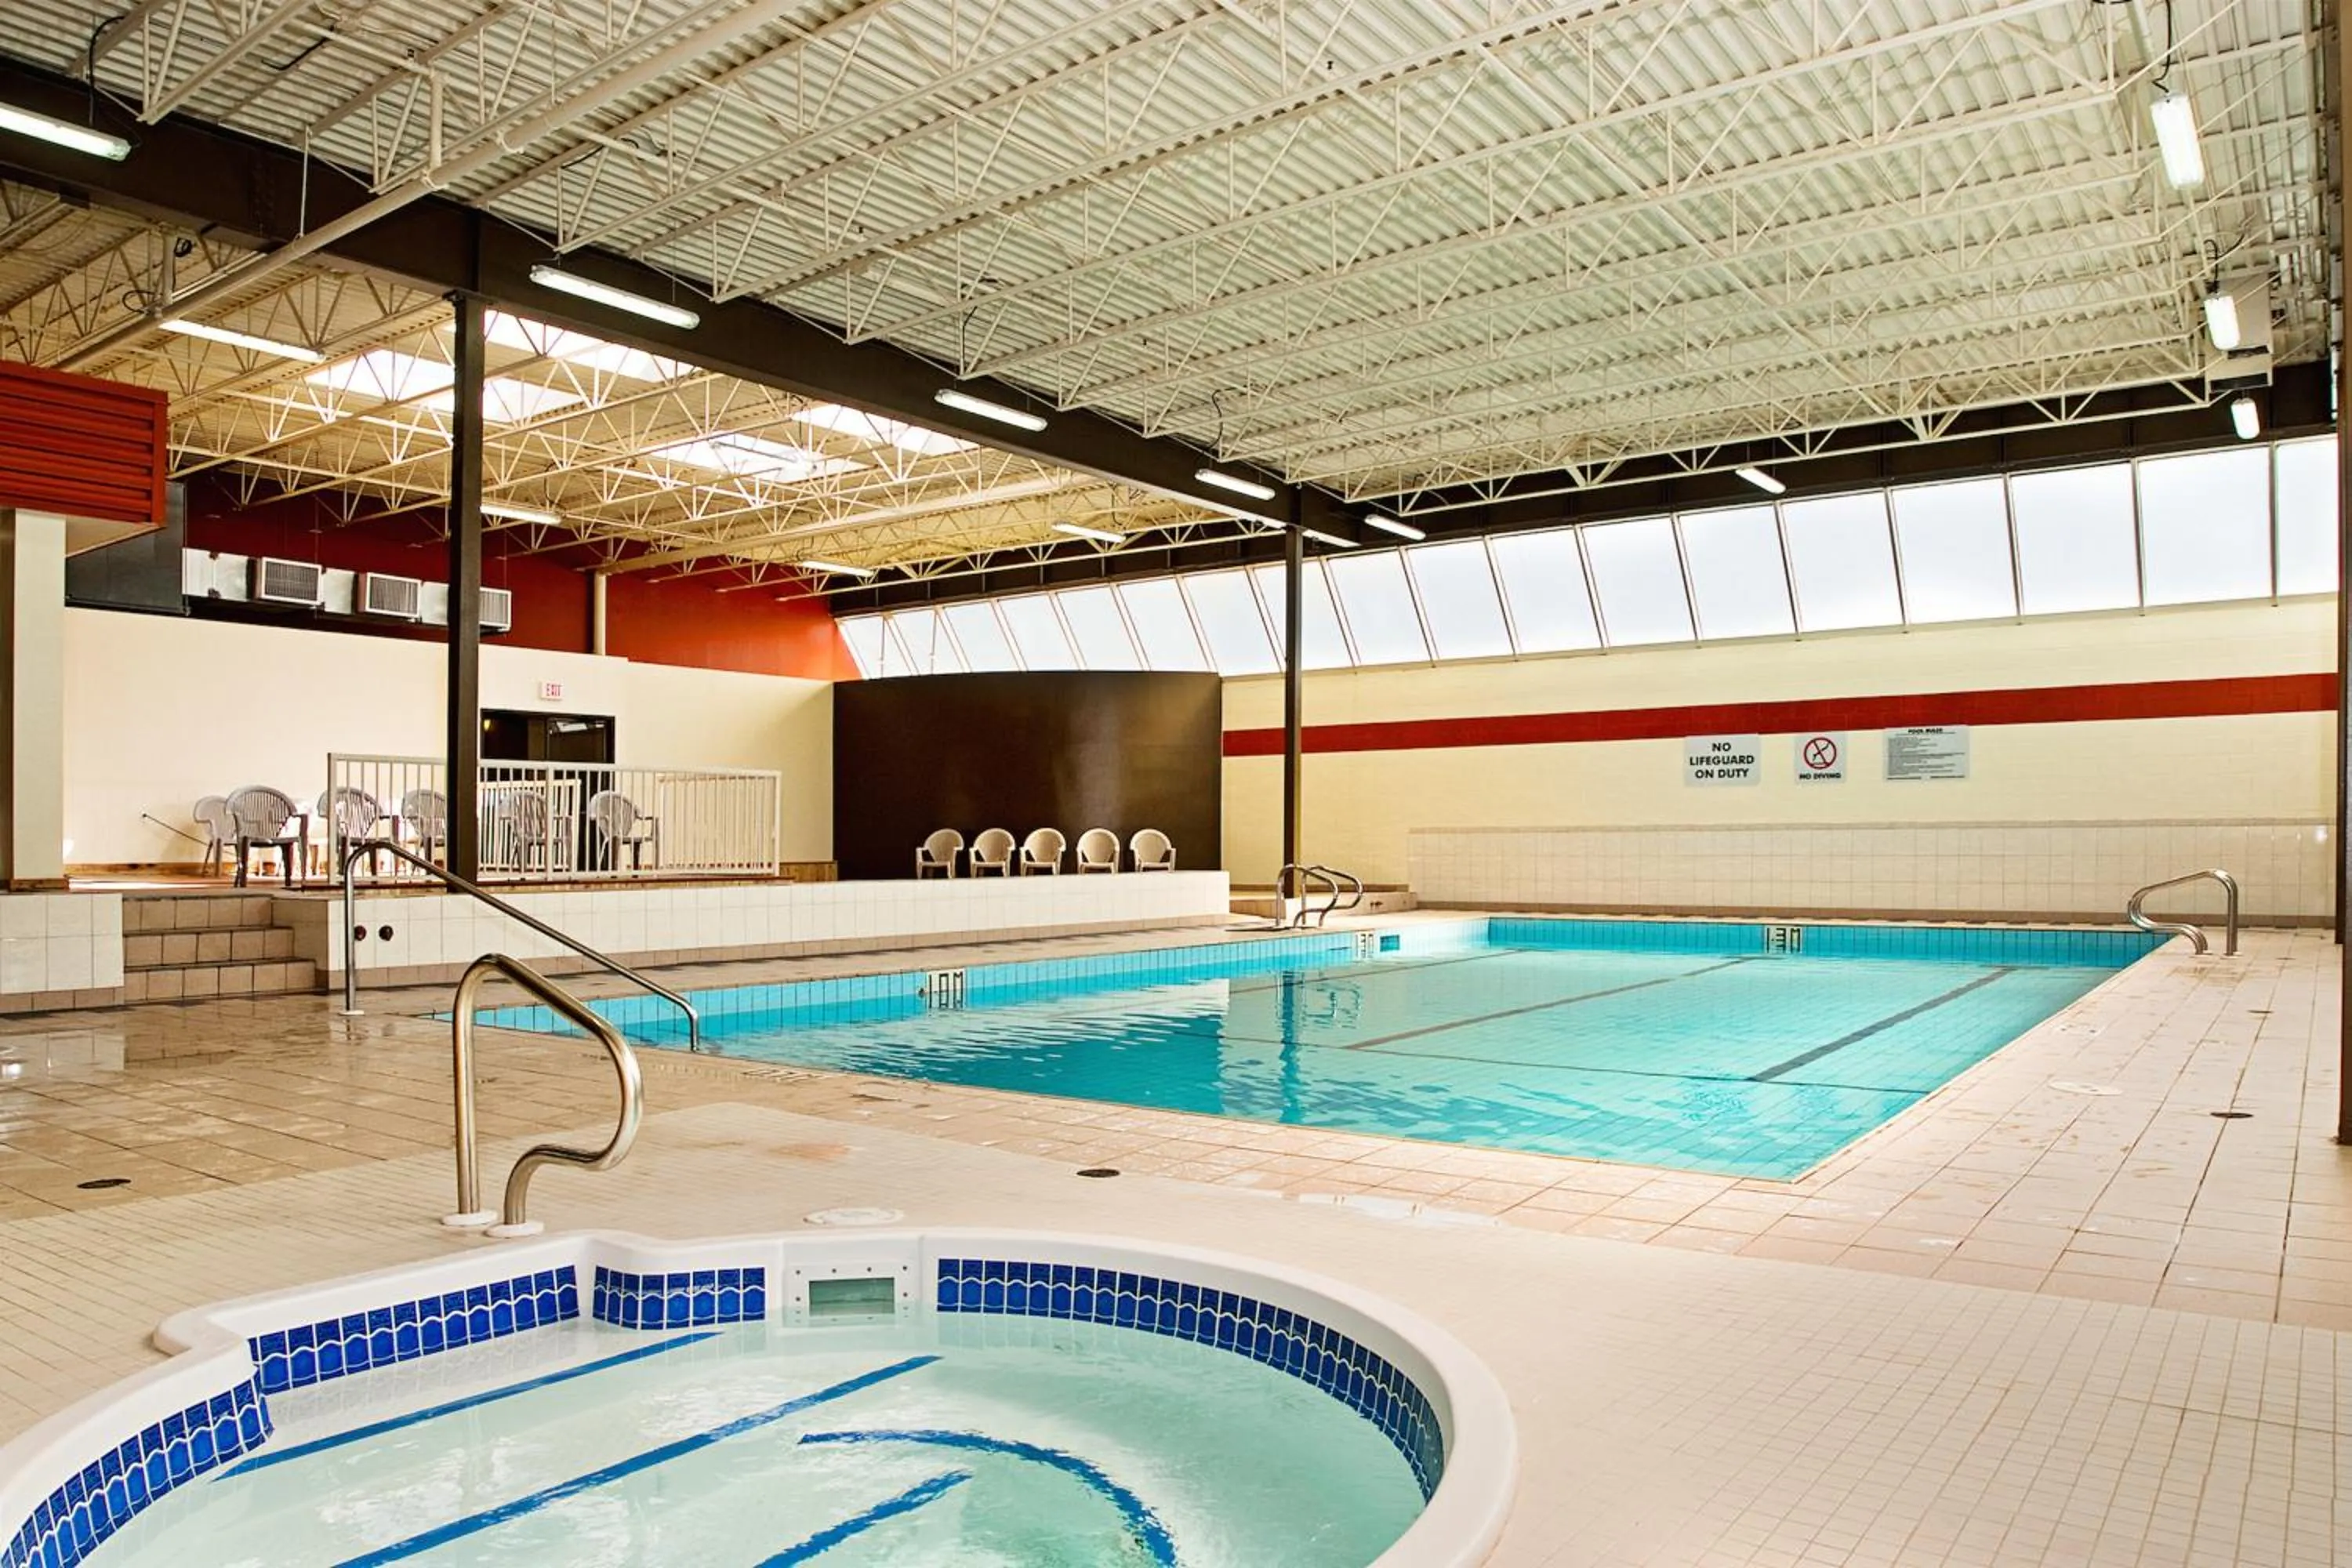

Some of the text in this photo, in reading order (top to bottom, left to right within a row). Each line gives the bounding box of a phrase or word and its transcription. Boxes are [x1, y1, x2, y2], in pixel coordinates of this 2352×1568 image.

[546, 683, 563, 696] EXIT
[1712, 742, 1731, 752] NO
[1690, 755, 1755, 766] LIFEGUARD
[1695, 768, 1749, 779] ON DUTY
